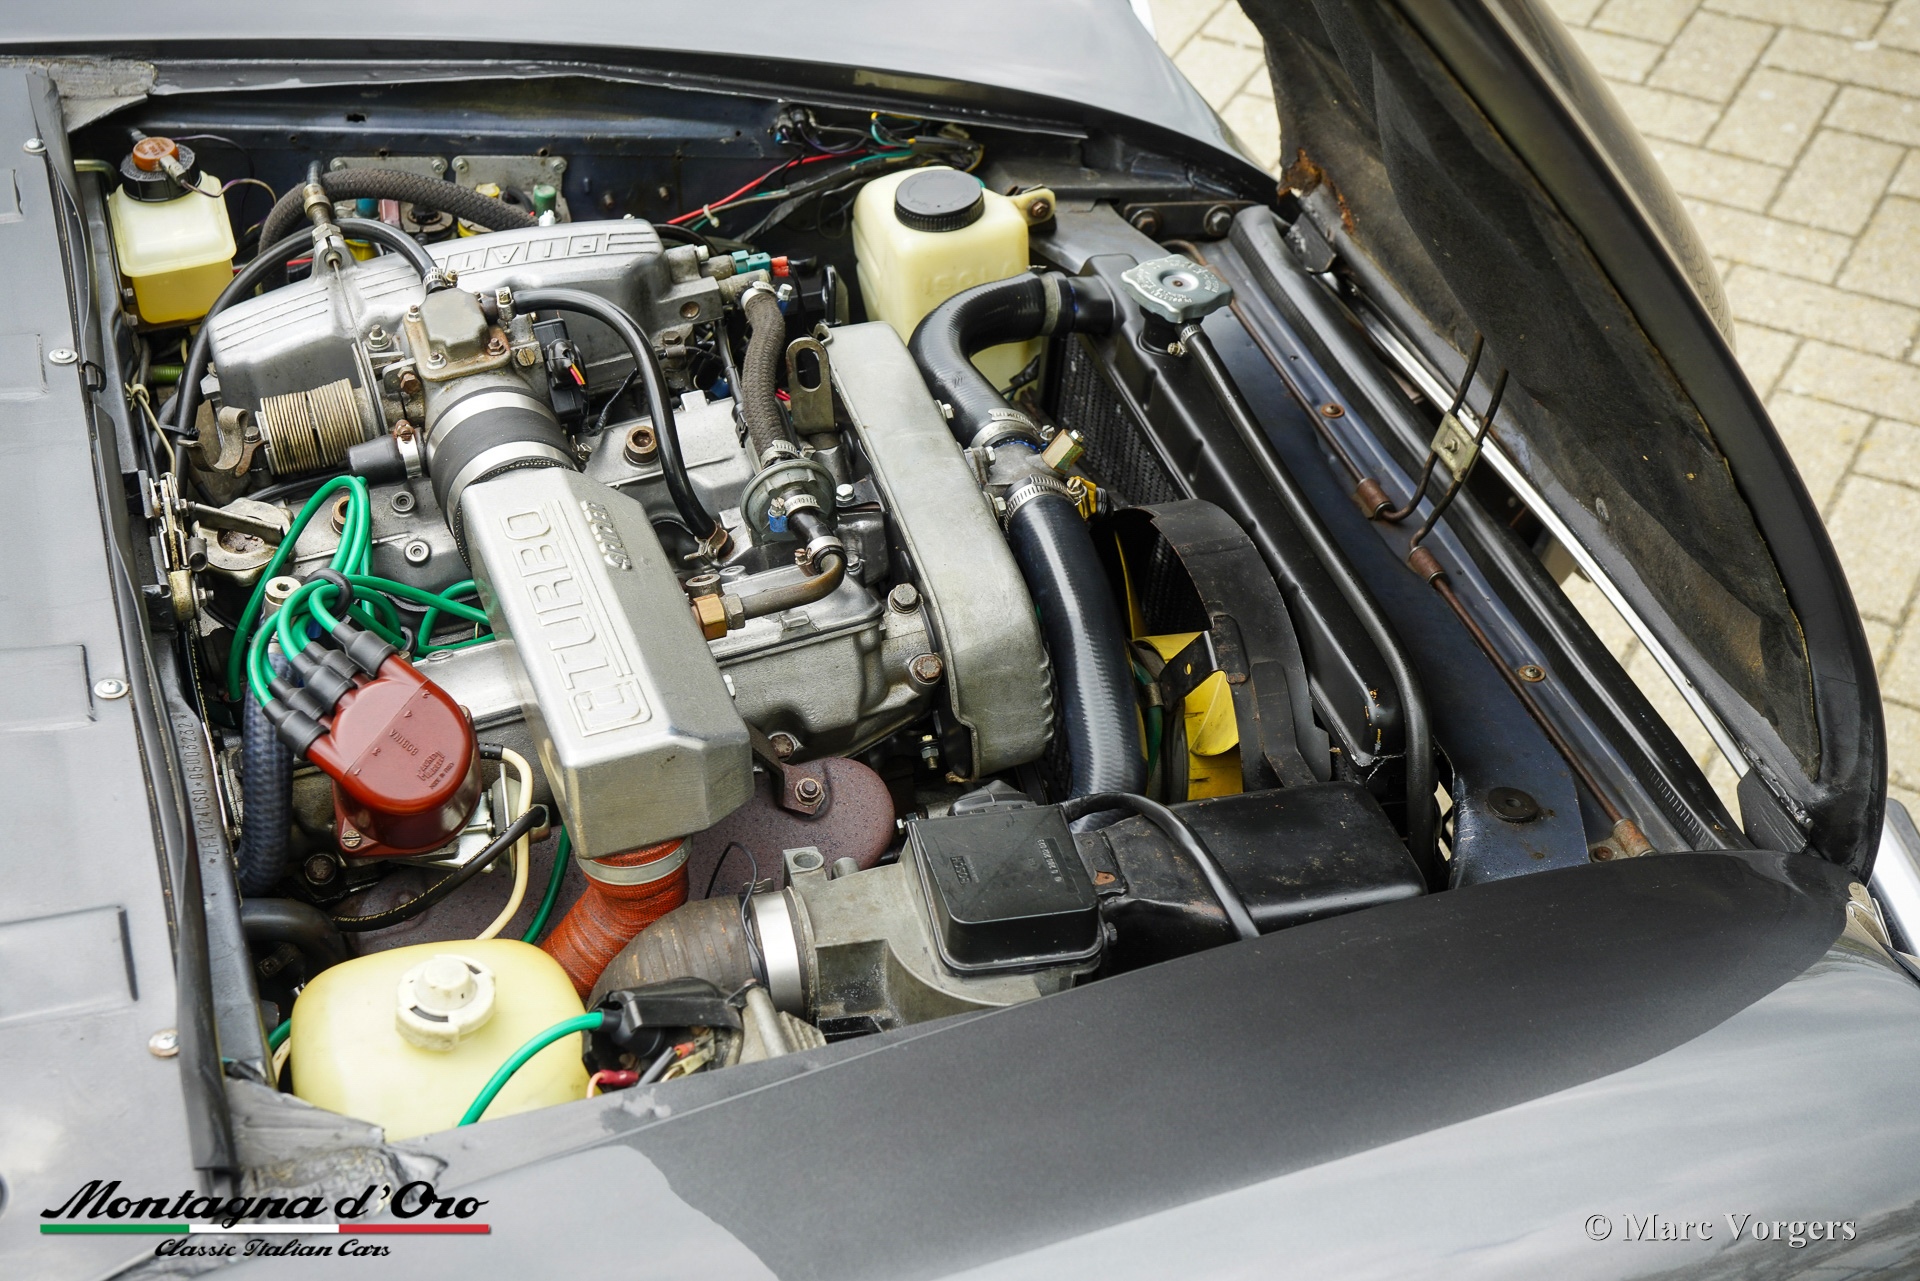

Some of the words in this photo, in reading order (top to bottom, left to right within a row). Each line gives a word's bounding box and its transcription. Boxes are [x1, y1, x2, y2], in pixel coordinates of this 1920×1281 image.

[460, 236, 599, 271] FIAT
[580, 500, 633, 571] SPIDER
[500, 503, 609, 690] TURBO
[421, 689, 431, 699] 2
[404, 710, 413, 719] 4
[951, 856, 971, 885] BOSCH
